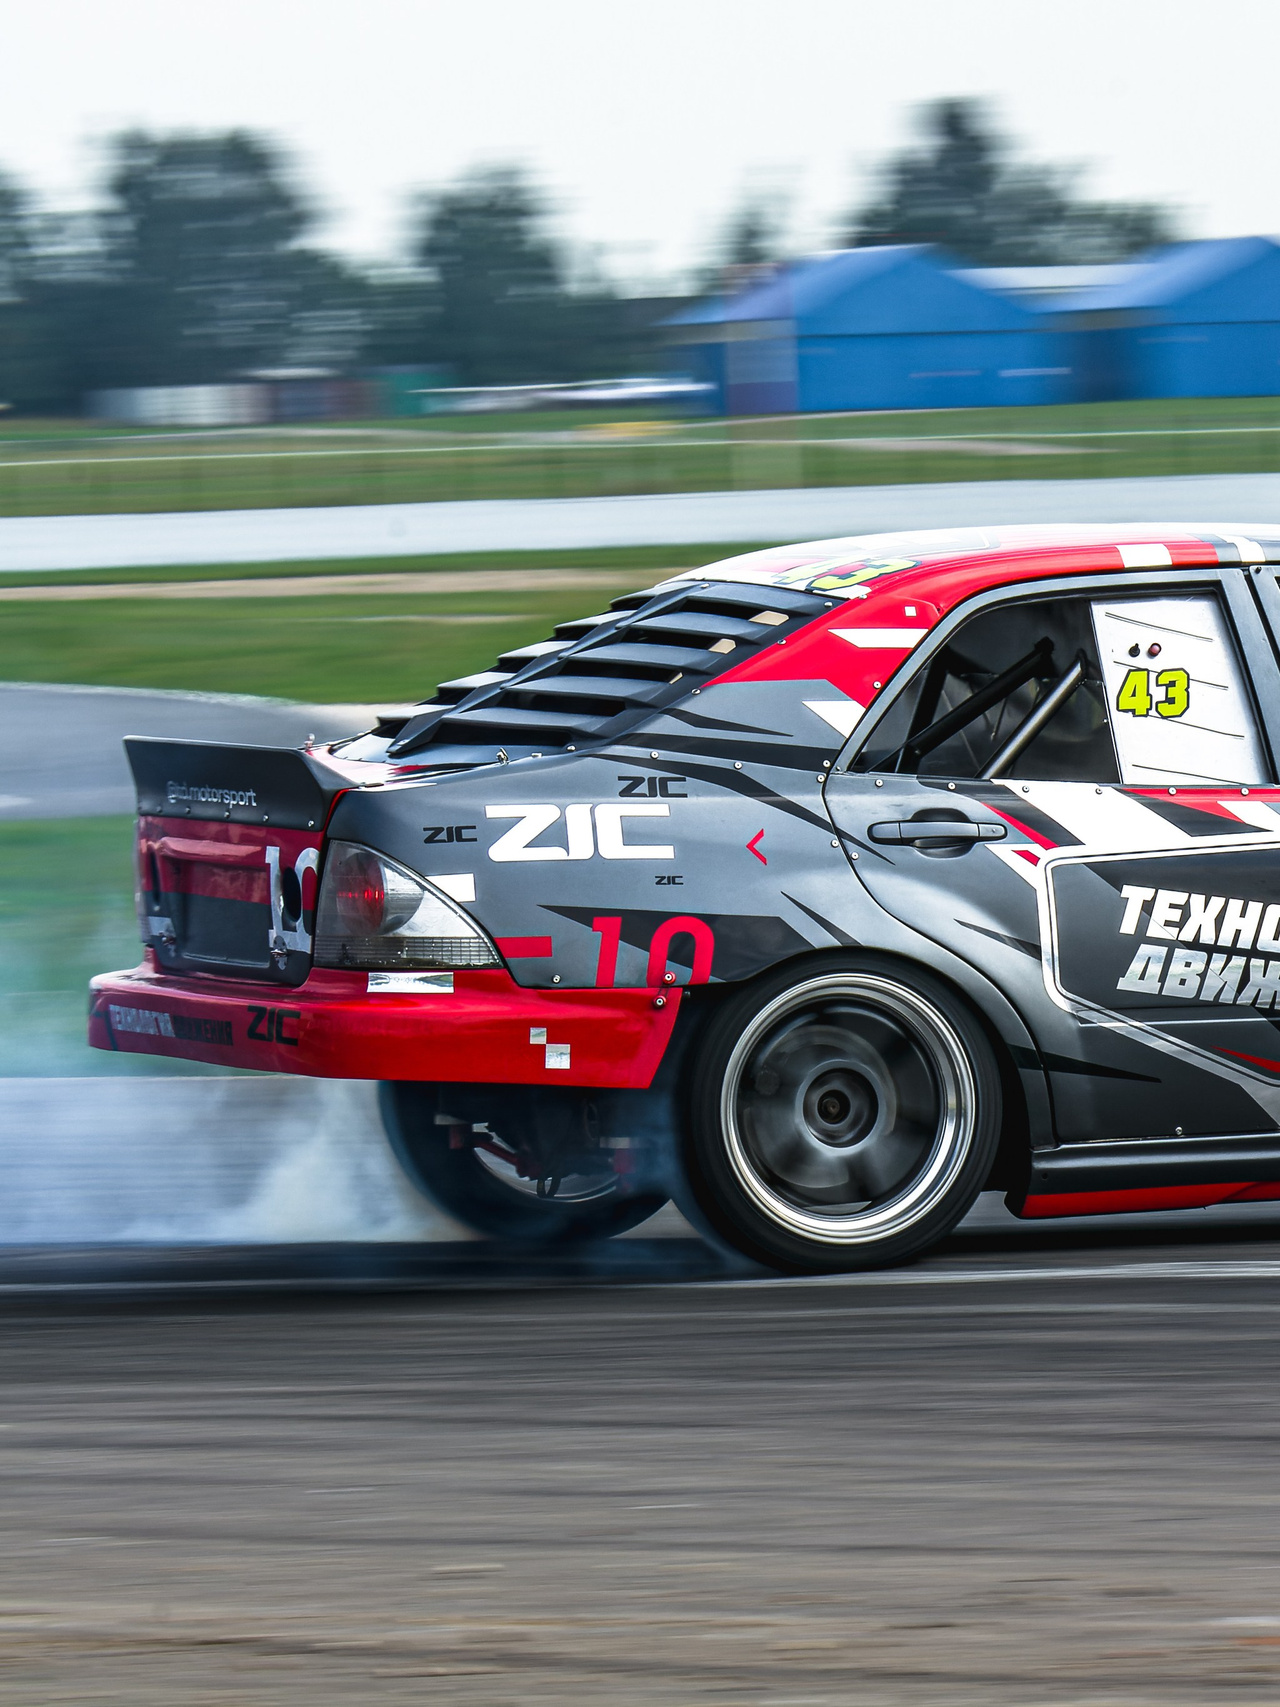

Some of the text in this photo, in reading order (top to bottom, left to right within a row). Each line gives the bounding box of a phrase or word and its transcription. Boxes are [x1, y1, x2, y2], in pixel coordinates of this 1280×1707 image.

[1116, 667, 1190, 719] 43
[617, 775, 689, 798] ZIC
[422, 825, 478, 844] ZIC
[484, 803, 676, 863] ZIC
[654, 875, 684, 886] ZIC
[247, 1004, 301, 1047] ZIC
